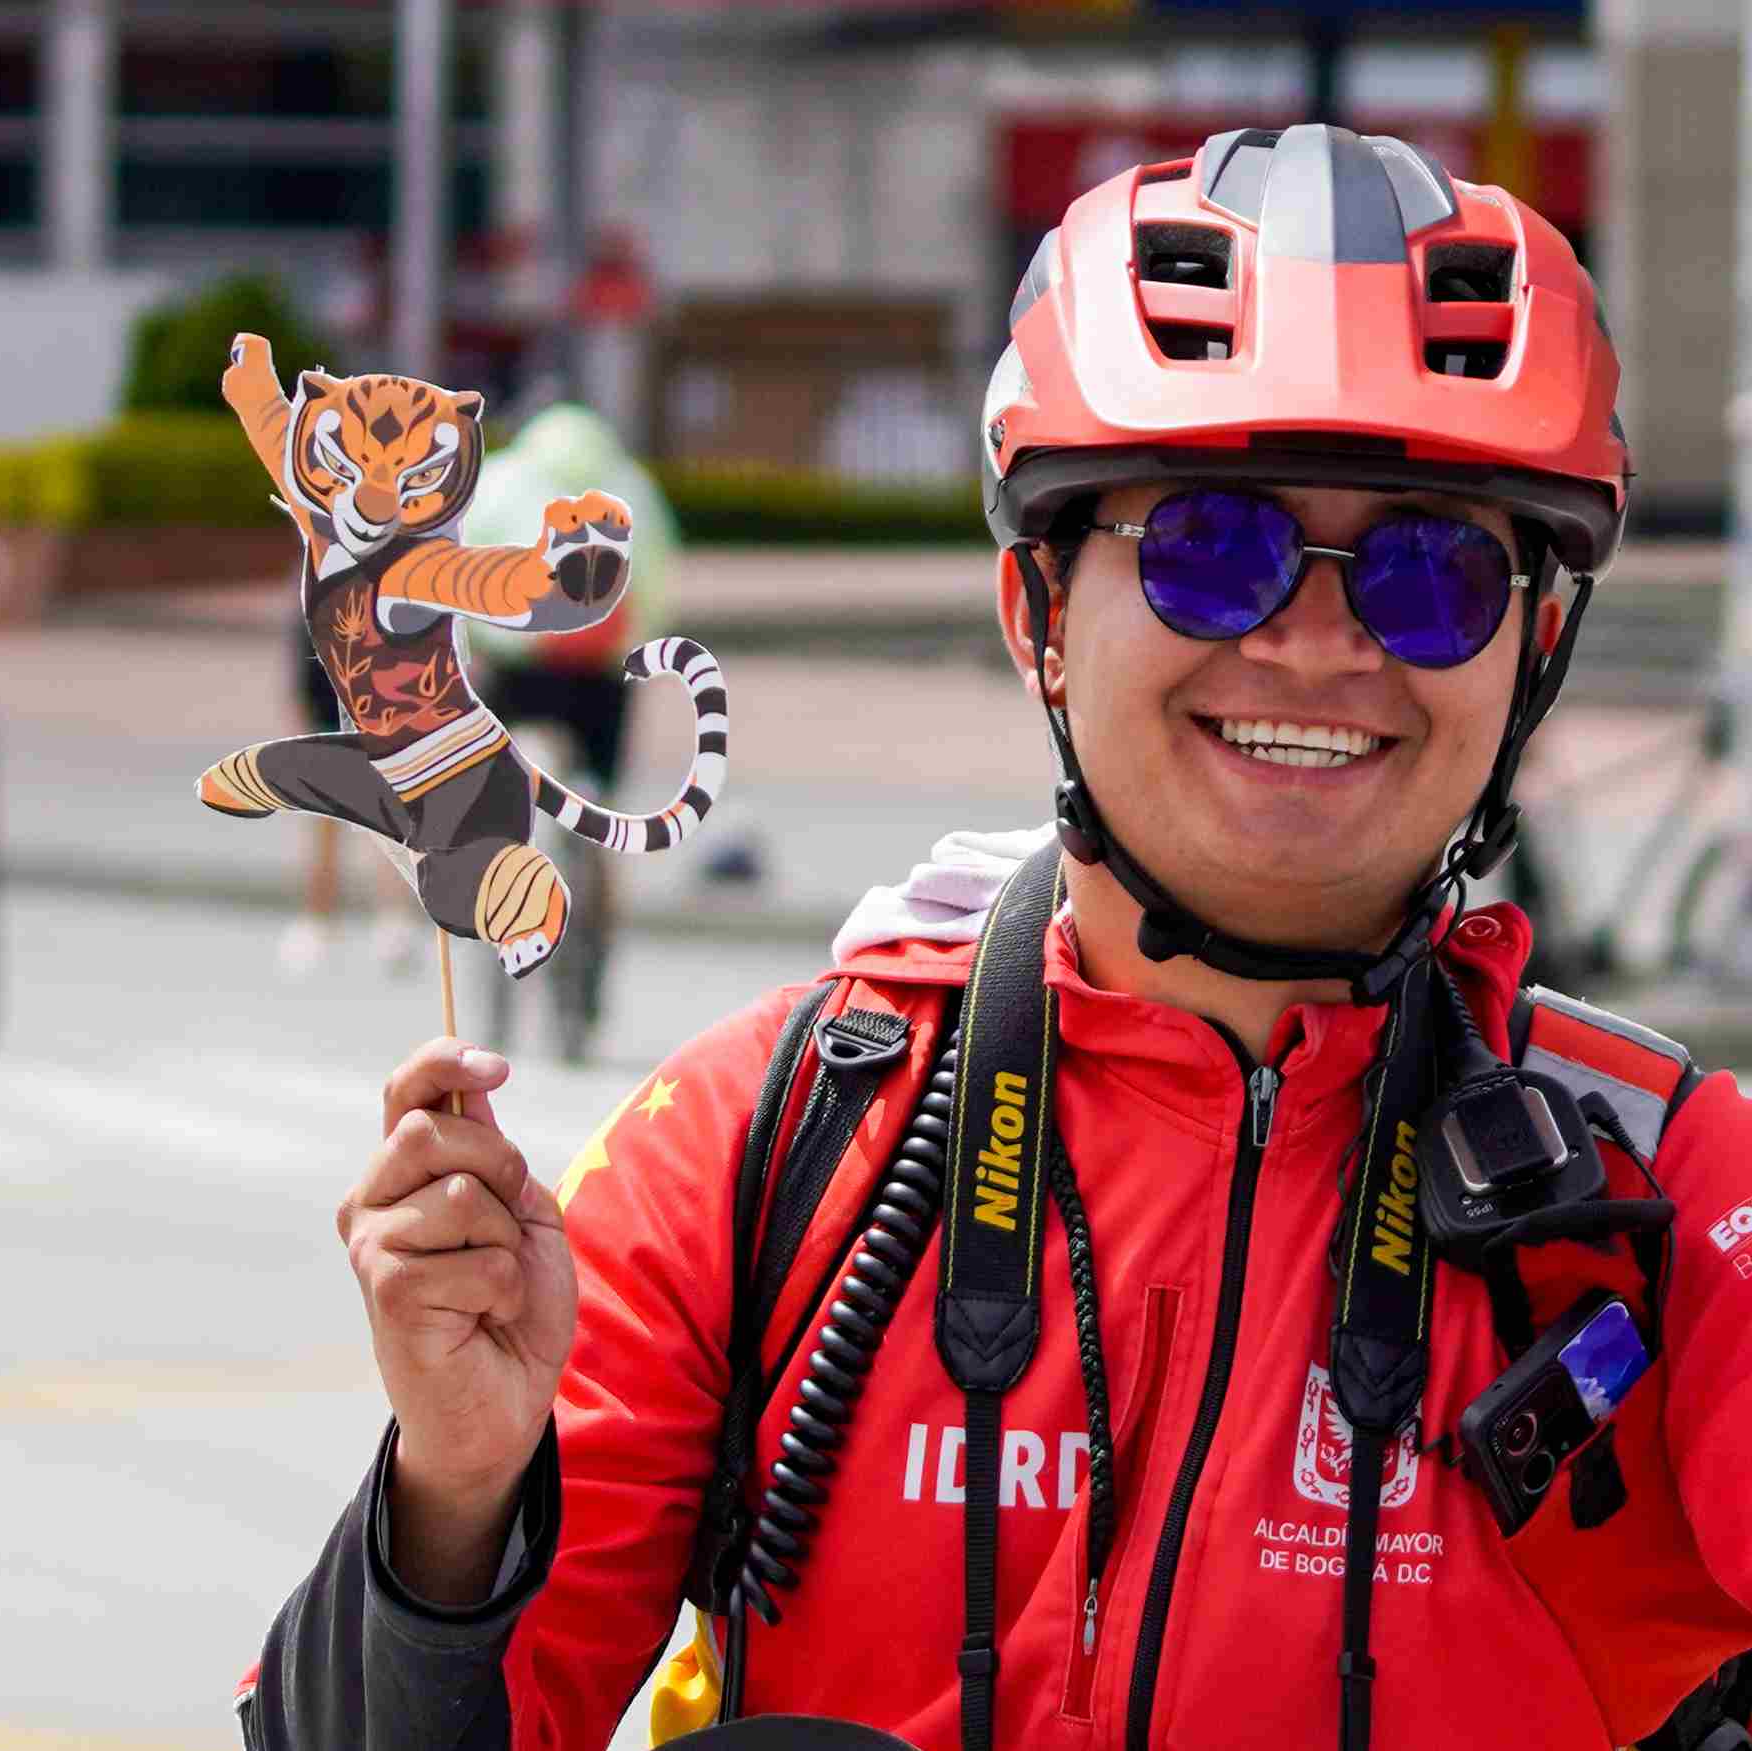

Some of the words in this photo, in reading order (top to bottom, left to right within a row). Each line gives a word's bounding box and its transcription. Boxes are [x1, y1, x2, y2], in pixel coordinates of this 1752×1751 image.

[974, 1071, 1027, 1231] Nikon
[1371, 1120, 1418, 1276] Nikon
[903, 1423, 1092, 1510] IDRD
[1254, 1518, 1347, 1548] ALCALDÍ
[1259, 1549, 1290, 1570] DE
[1295, 1553, 1388, 1583] BOGÁ
[1397, 1563, 1433, 1584] D.C.
